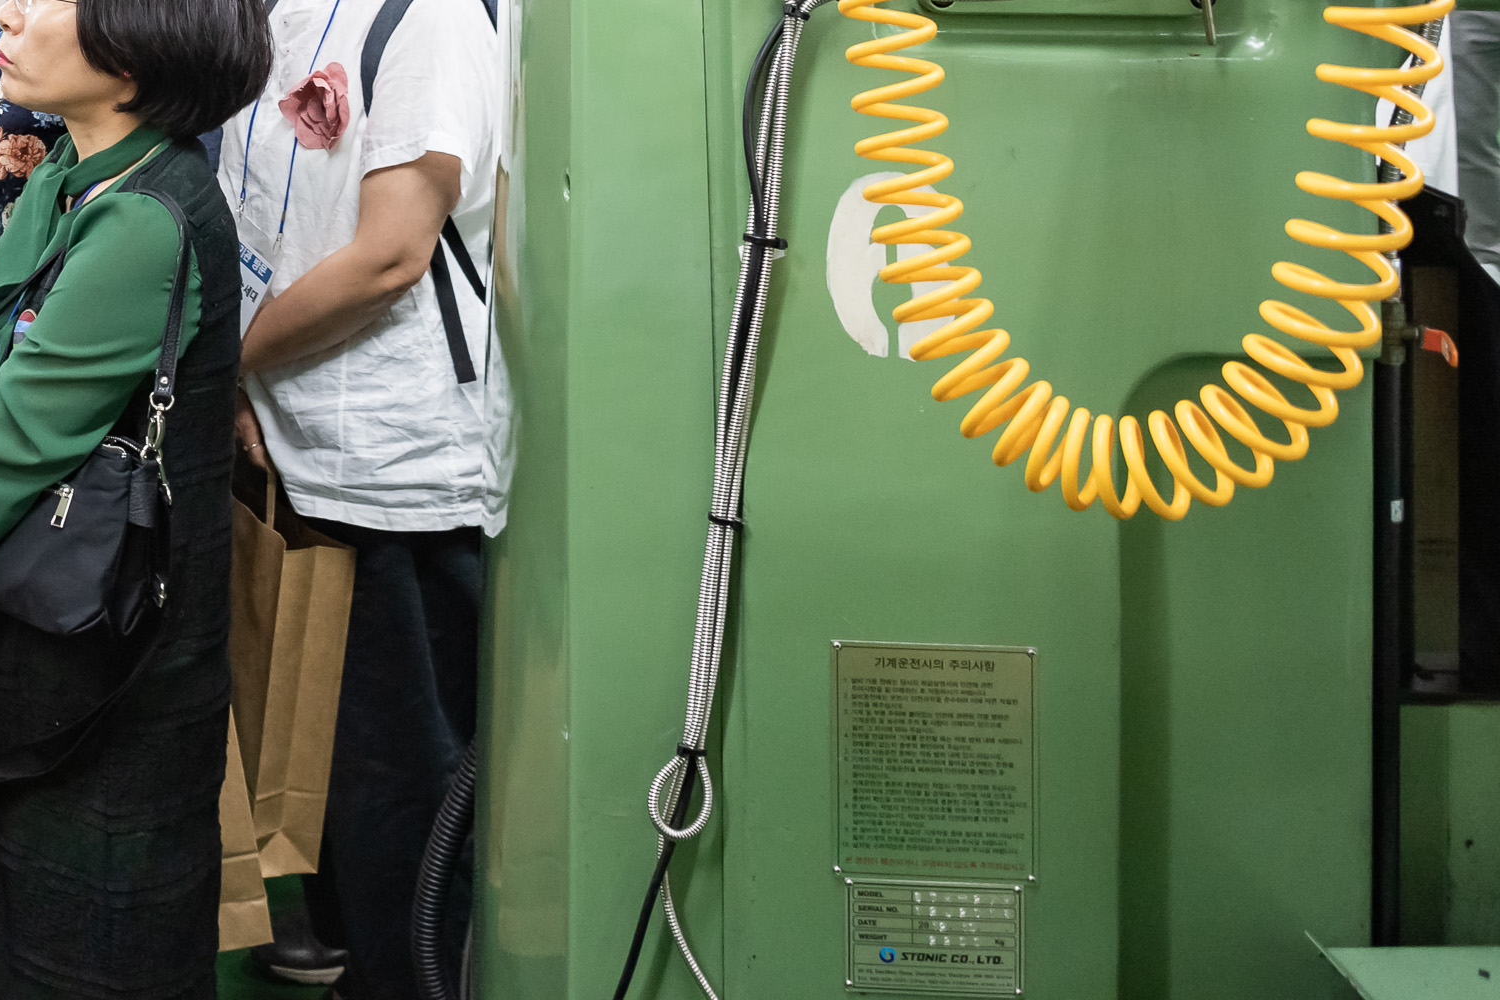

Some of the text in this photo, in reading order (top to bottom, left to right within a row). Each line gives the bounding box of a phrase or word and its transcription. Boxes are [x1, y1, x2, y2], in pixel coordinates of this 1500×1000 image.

[252, 257, 267, 277] 방문
[874, 656, 995, 672] 기계운전시의 주의사항
[857, 890, 884, 898] MODEL
[858, 904, 885, 913] SERIAL
[857, 919, 877, 927] DATE
[858, 933, 888, 941] WEIGHT
[900, 951, 947, 963] STONIC
